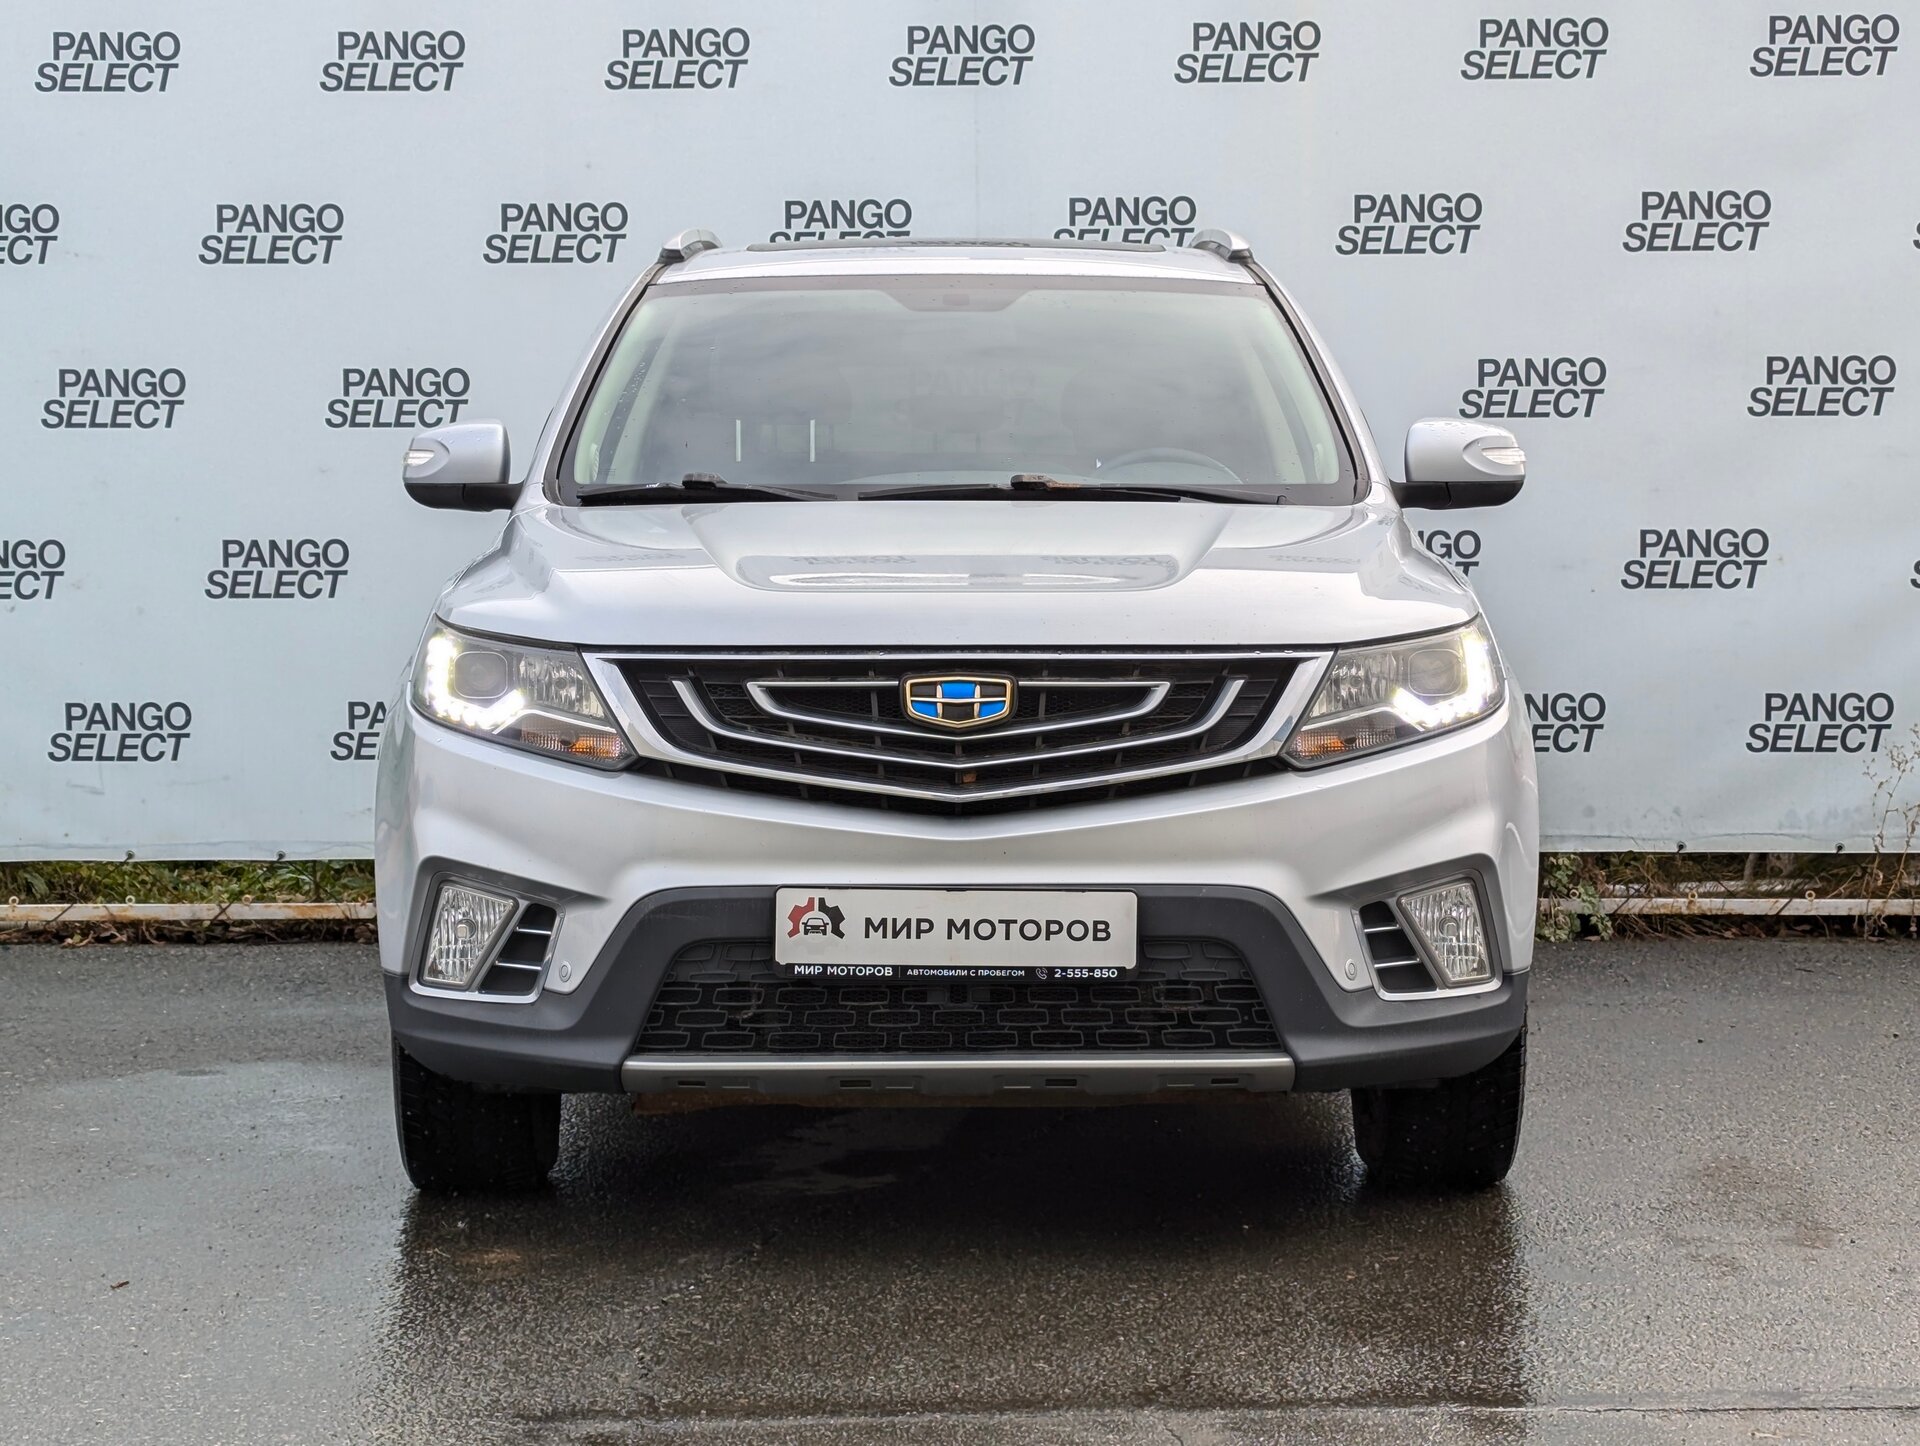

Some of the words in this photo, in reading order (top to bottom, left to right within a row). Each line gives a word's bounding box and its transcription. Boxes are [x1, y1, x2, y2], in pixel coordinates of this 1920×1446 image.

[623, 28, 749, 58] PANGO
[908, 24, 1035, 54] PANGO
[1194, 21, 1320, 51] PANGO
[1480, 18, 1608, 48] PANGO
[1770, 14, 1899, 44] PANGO
[53, 32, 180, 61] PANGO
[338, 31, 465, 60] PANGO
[605, 59, 748, 90] SELECT
[889, 56, 1034, 86] SELECT
[1175, 53, 1319, 83] SELECT
[1461, 49, 1607, 80] SELECT
[1750, 46, 1898, 77] SELECT
[35, 63, 179, 92] SELECT
[320, 62, 464, 91] SELECT
[0, 204, 59, 233] GO
[217, 204, 343, 233] PANGO
[501, 202, 628, 232] PANGO
[785, 199, 912, 229] PANGO
[1069, 196, 1196, 226] PANGO
[1355, 193, 1482, 223] PANGO
[1642, 190, 1771, 220] PANGO
[199, 235, 342, 264] SELECT
[483, 234, 627, 263] SELECT
[1336, 225, 1481, 255] SELECT
[1623, 222, 1769, 252] SELECT
[59, 368, 186, 397] PANGO
[343, 368, 470, 397] PANGO
[1478, 357, 1606, 387] PANGO
[1767, 355, 1896, 385] PANGO
[41, 399, 184, 428] SELECT
[325, 399, 469, 428] SELECT
[1459, 389, 1605, 418] SELECT
[1747, 387, 1895, 417] SELECT
[223, 539, 349, 568] PANGO
[1417, 529, 1481, 559] GO
[1640, 529, 1769, 558] PANGO
[205, 570, 348, 599] SELECT
[1621, 560, 1768, 589] SELECT
[65, 702, 191, 731] PANGO
[1765, 693, 1894, 722] PANGO
[48, 733, 190, 762] SELECT
[1746, 724, 1892, 753] SELECT
[864, 917, 934, 940] МИР
[947, 918, 1111, 942] МОТОРОВ
[794, 965, 822, 975] МИР
[827, 966, 893, 976] МОТОРОВ
[907, 968, 967, 977] АВТОМОБИЛИ
[978, 969, 1025, 977] ПРОБЕГОМ
[1054, 968, 1118, 978] 2-555-850
